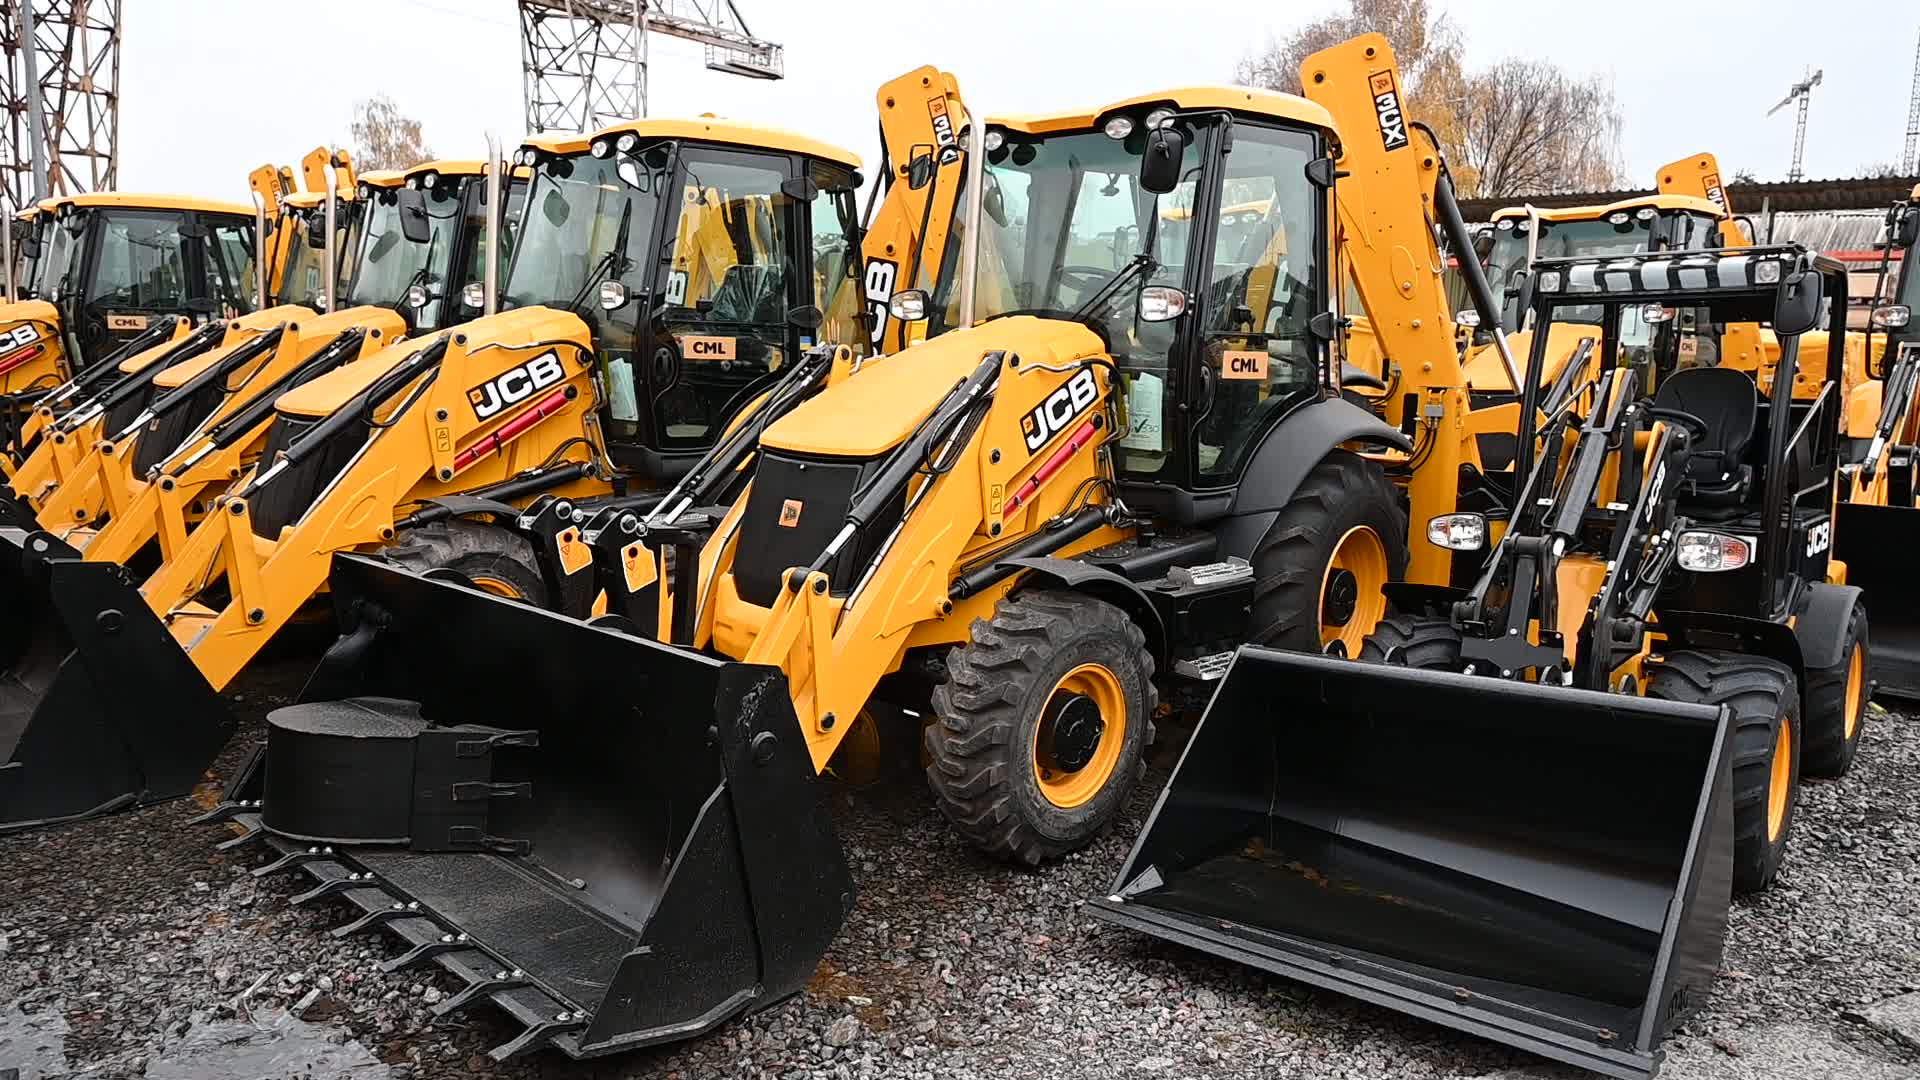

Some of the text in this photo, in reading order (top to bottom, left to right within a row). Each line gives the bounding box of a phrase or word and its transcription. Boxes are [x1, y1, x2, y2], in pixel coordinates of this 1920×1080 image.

[1376, 92, 1406, 145] 3CX
[114, 319, 139, 327] CML
[866, 261, 895, 355] CB
[0, 324, 39, 353] CB
[692, 341, 726, 355] CML
[1231, 357, 1259, 373] CML
[475, 353, 562, 418] JCB
[1026, 369, 1097, 450] JCB
[1806, 521, 1830, 558] JCB
